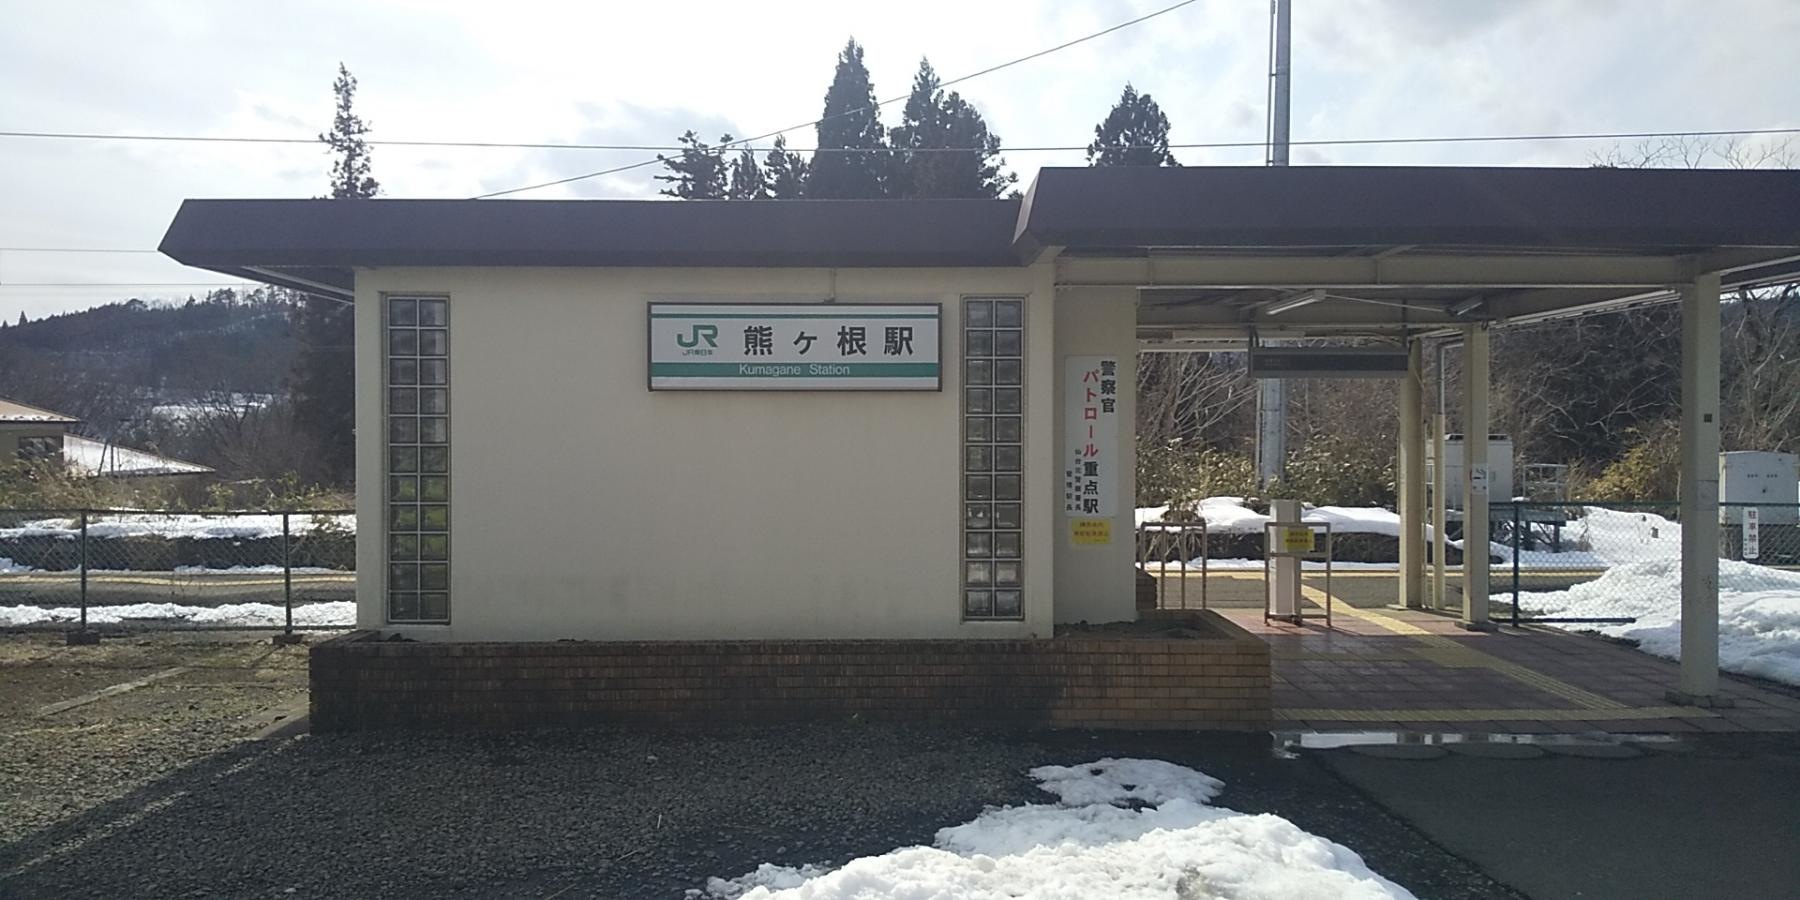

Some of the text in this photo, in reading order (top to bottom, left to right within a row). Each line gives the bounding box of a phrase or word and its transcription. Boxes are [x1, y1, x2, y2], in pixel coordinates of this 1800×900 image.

[677, 324, 719, 348] JR
[743, 325, 914, 356] 熊ヶ根駅
[739, 363, 850, 377] Kumagane Station
[1101, 360, 1116, 413] 警察官
[1082, 369, 1099, 514] パトロール重点駅
[1748, 510, 1757, 555] 駐車禁止
